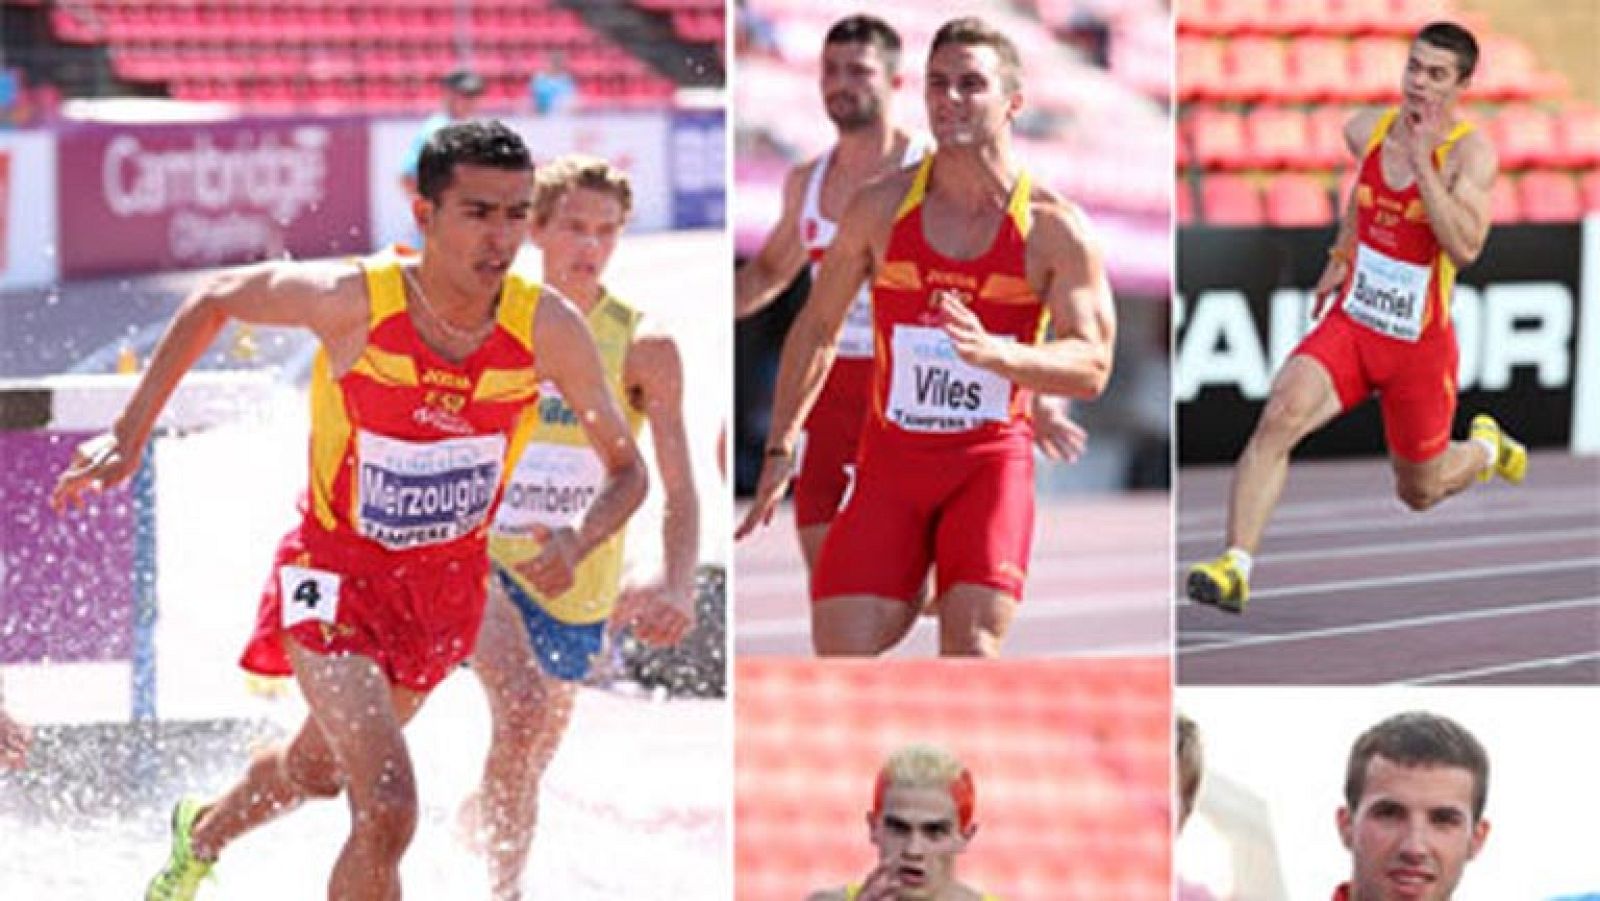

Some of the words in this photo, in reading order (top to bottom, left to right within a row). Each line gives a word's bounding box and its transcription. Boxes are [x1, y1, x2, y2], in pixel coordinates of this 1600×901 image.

[103, 131, 327, 224] Cambridge
[913, 364, 982, 411] Viles
[294, 579, 321, 608] 4
